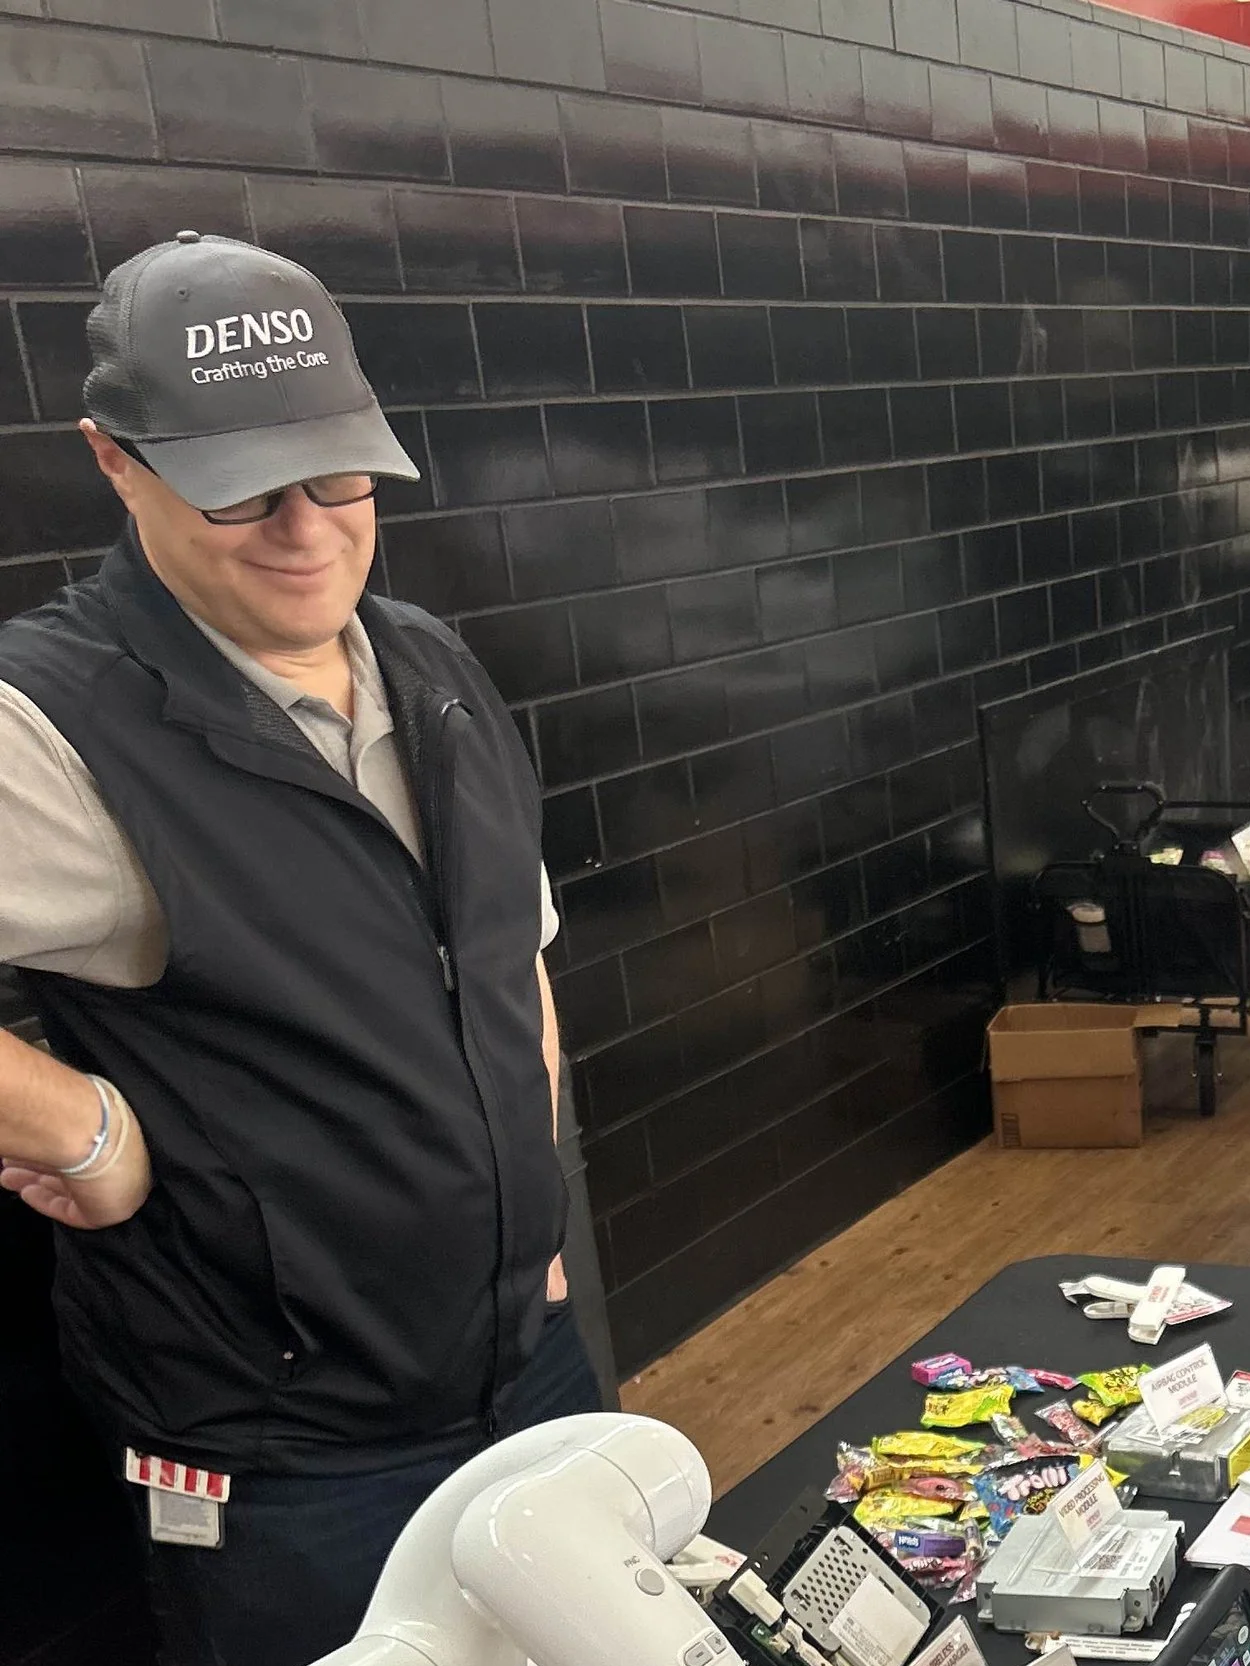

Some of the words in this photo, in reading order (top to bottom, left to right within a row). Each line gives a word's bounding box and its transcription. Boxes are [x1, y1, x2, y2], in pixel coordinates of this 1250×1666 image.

[185, 308, 315, 359] DENSO
[191, 360, 268, 385] Crafting
[266, 355, 297, 374] the
[297, 351, 329, 368] Core
[1151, 1373, 1177, 1392] AIRBAG
[1175, 1358, 1207, 1379] CONTROL
[1168, 1374, 1198, 1394] MODULE
[999, 1465, 1069, 1501] Trolli
